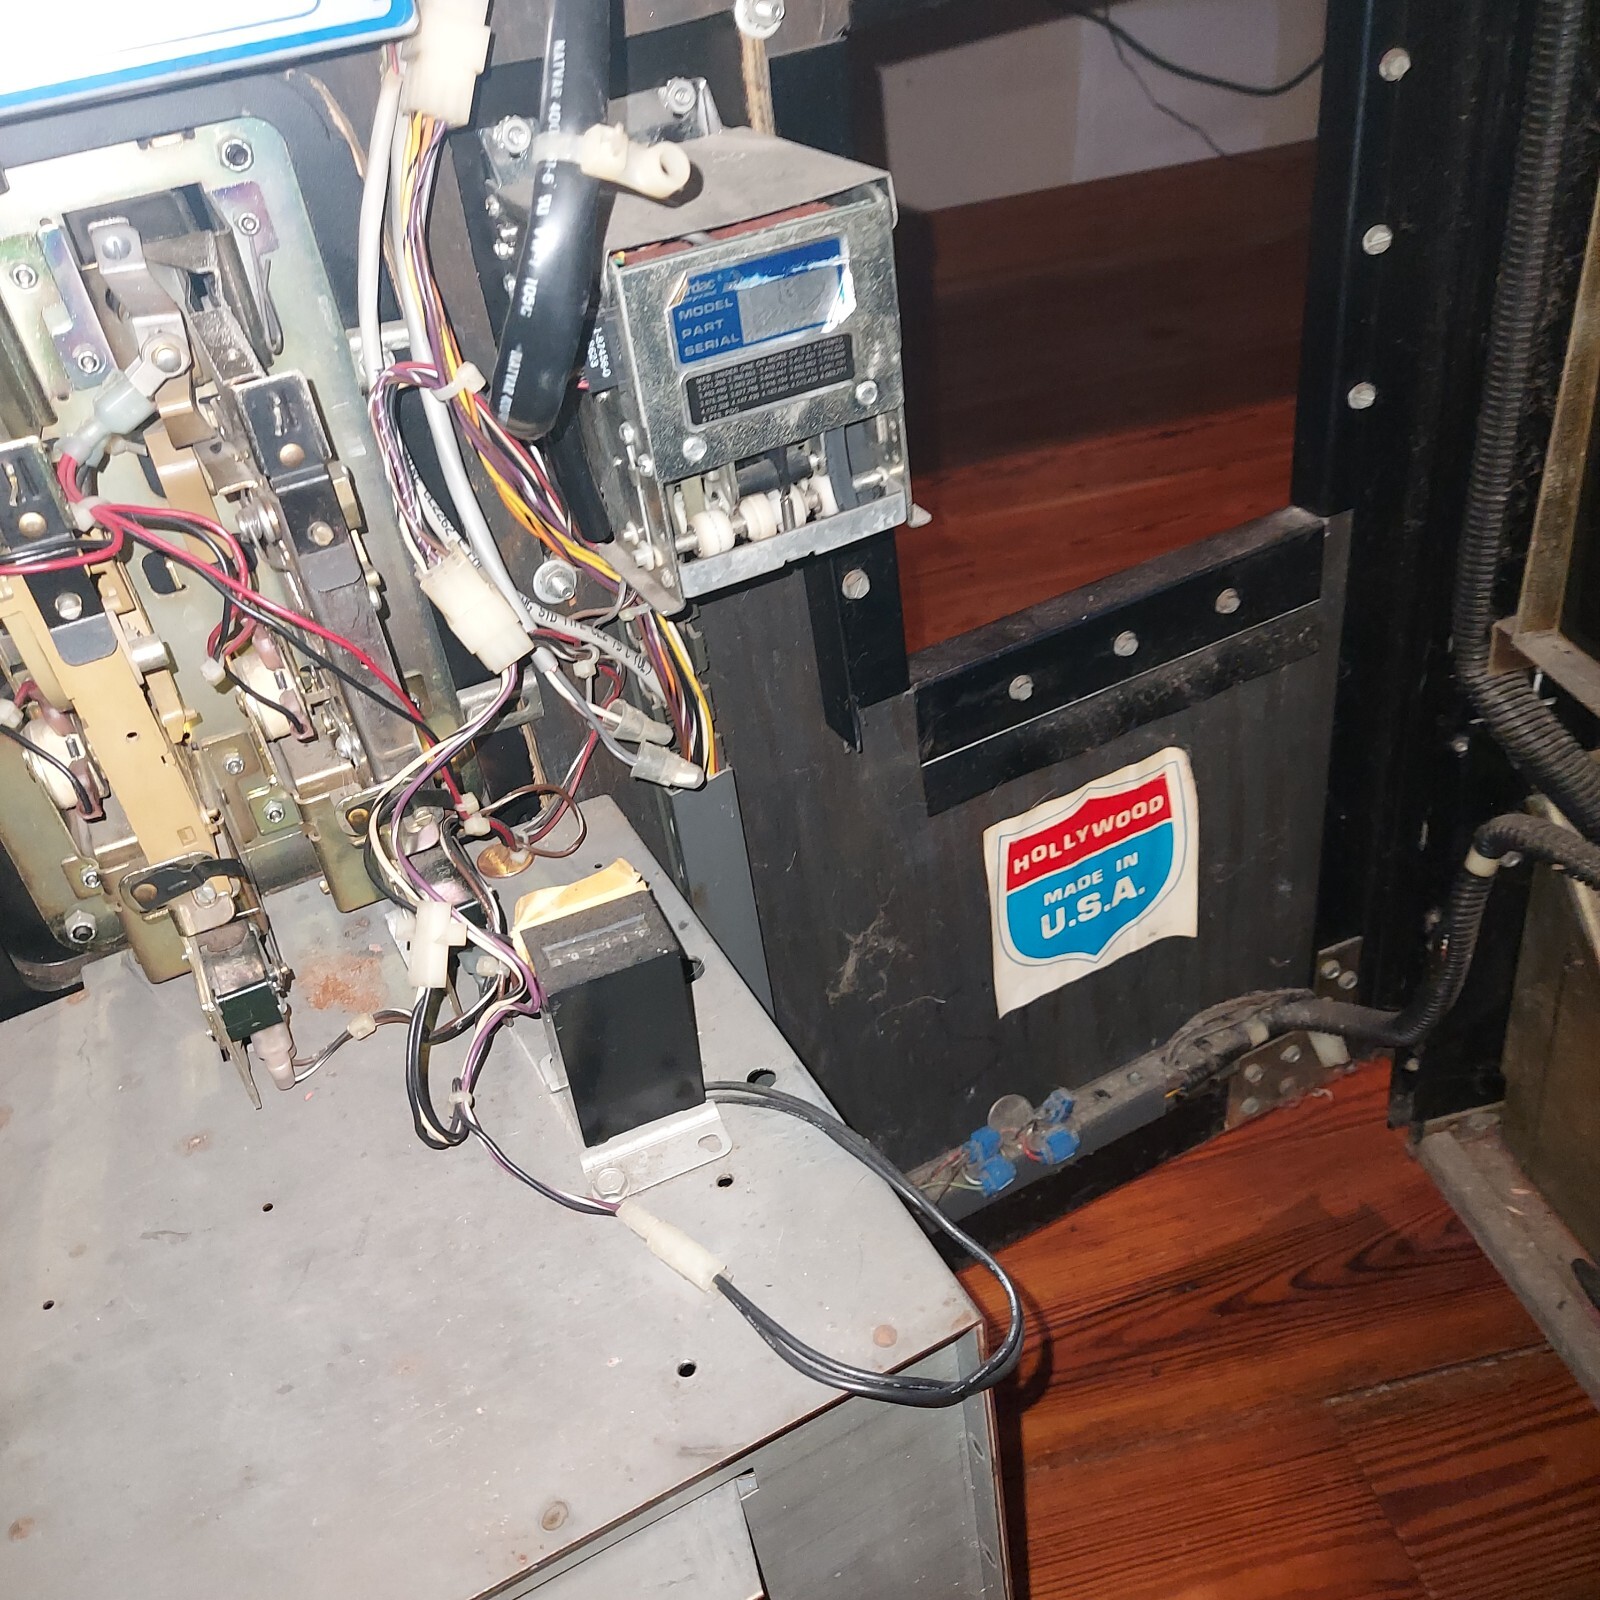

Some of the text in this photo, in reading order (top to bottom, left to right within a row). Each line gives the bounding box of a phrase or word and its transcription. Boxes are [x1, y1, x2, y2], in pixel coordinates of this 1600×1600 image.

[678, 298, 734, 322] MODEL
[681, 319, 724, 340] PART
[683, 333, 741, 357] SERIAL
[1013, 794, 1165, 875] HOLLYWOOD
[1043, 851, 1139, 906] MADE IN
[1040, 875, 1146, 940] U.S.A.
